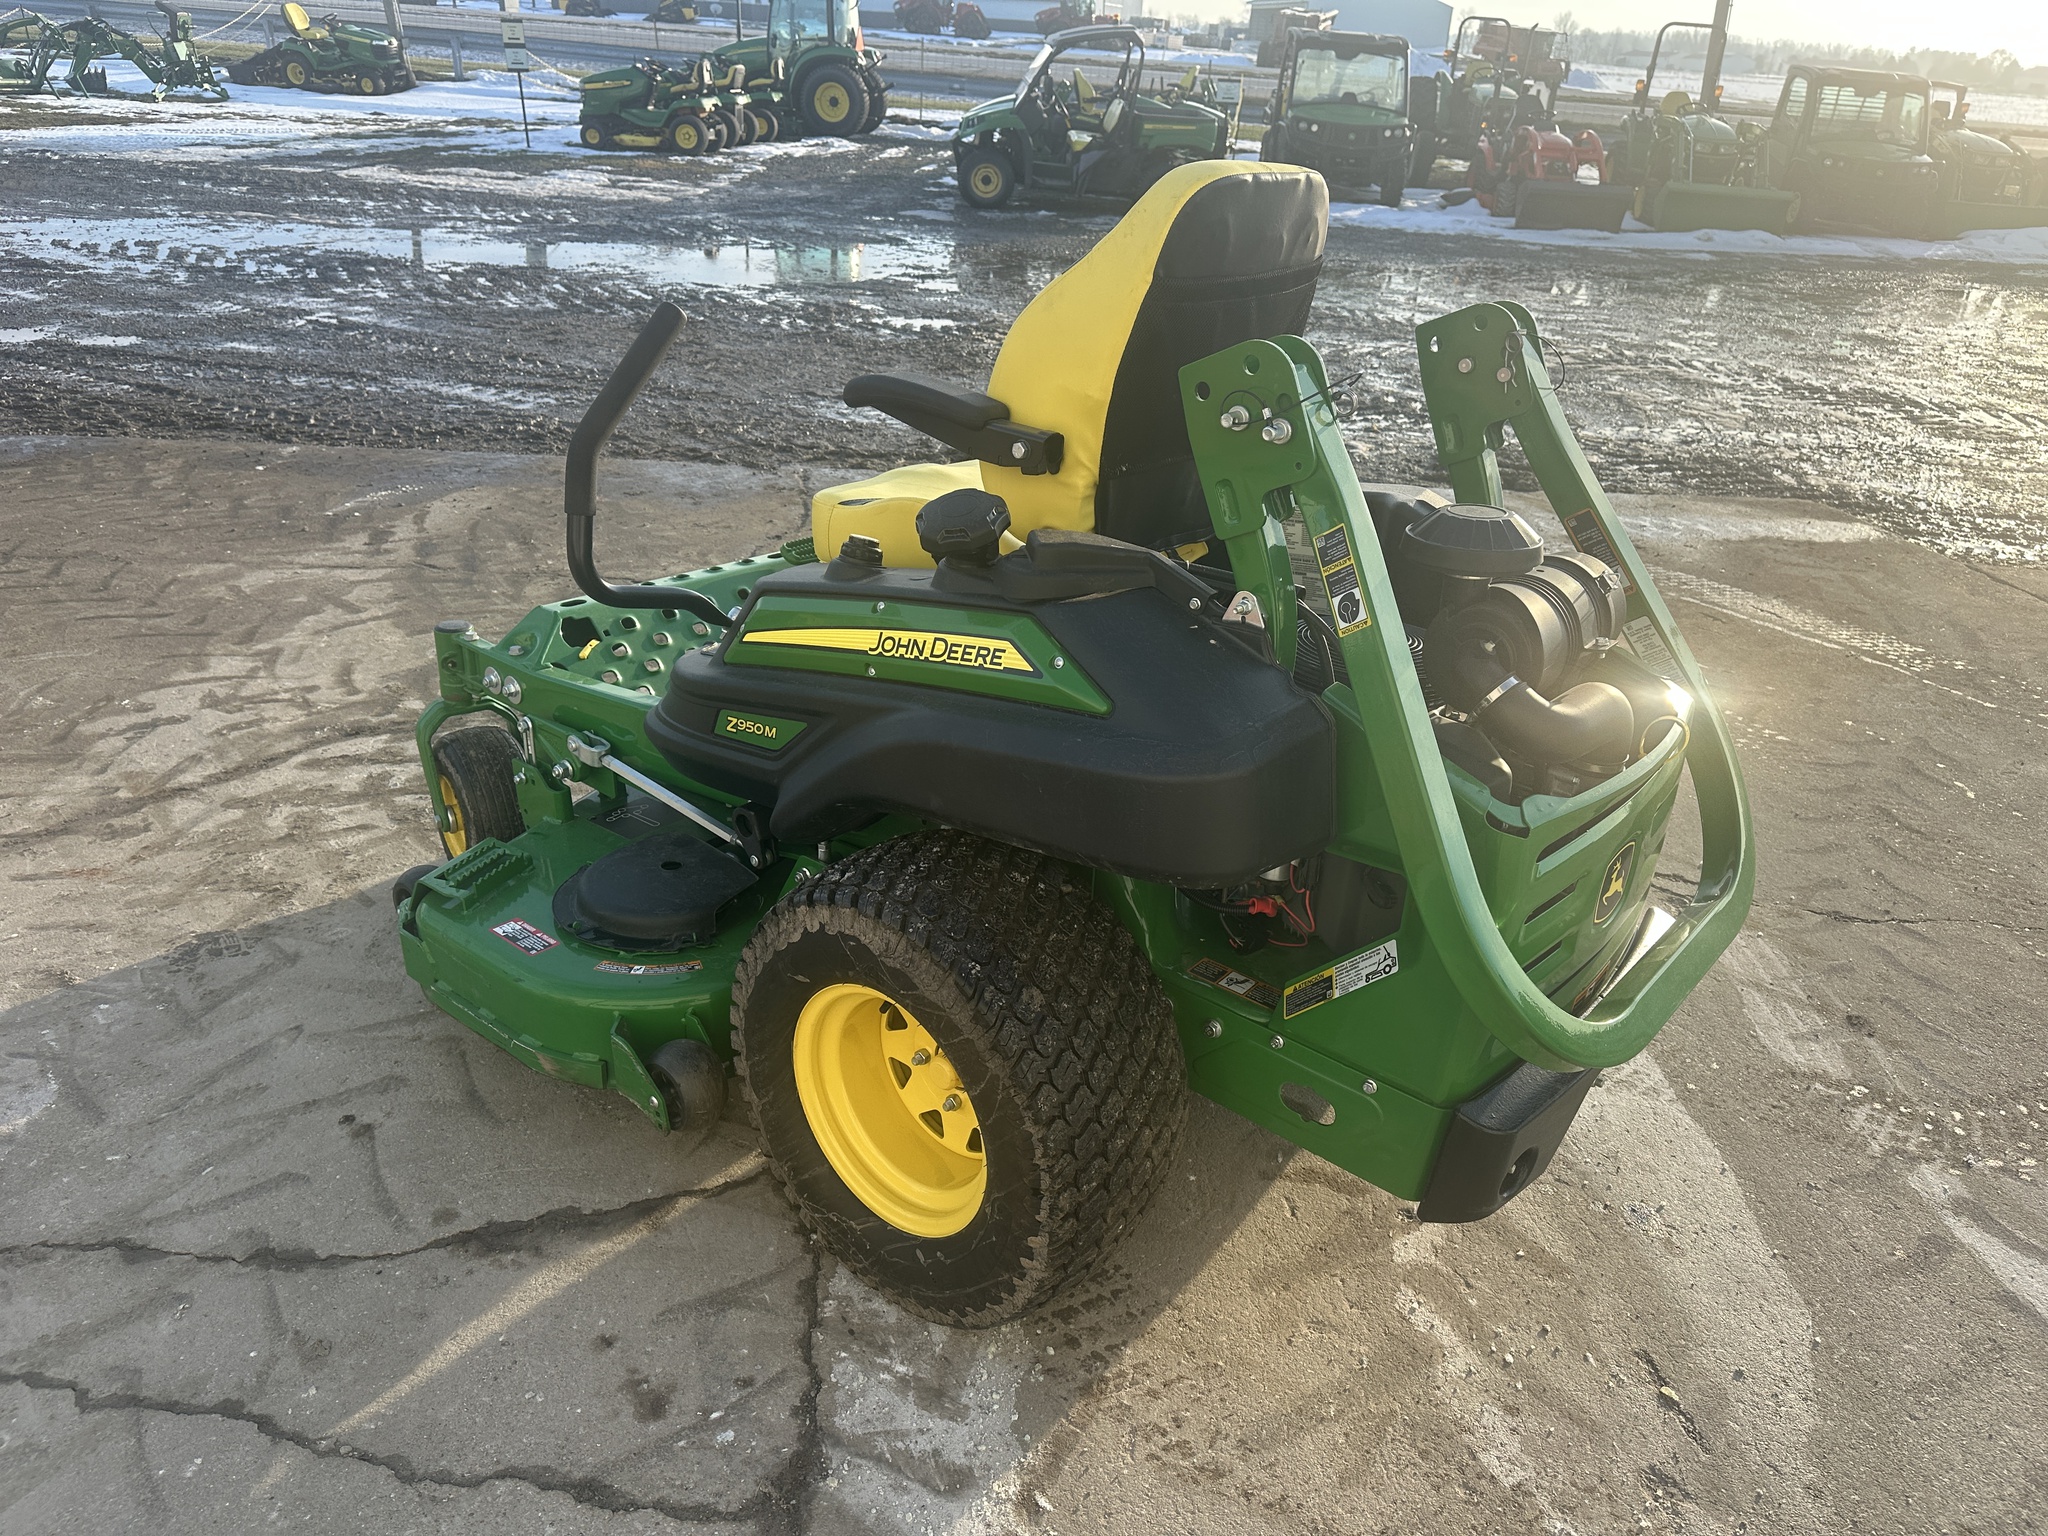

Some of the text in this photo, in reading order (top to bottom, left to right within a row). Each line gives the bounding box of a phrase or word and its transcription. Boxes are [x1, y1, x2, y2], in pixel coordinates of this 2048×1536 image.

[1342, 622, 1364, 636] CAUTION
[868, 632, 1006, 666] JOHN DEERE
[726, 716, 777, 739] Z950M
[1298, 973, 1325, 989] ATENCIÓN
